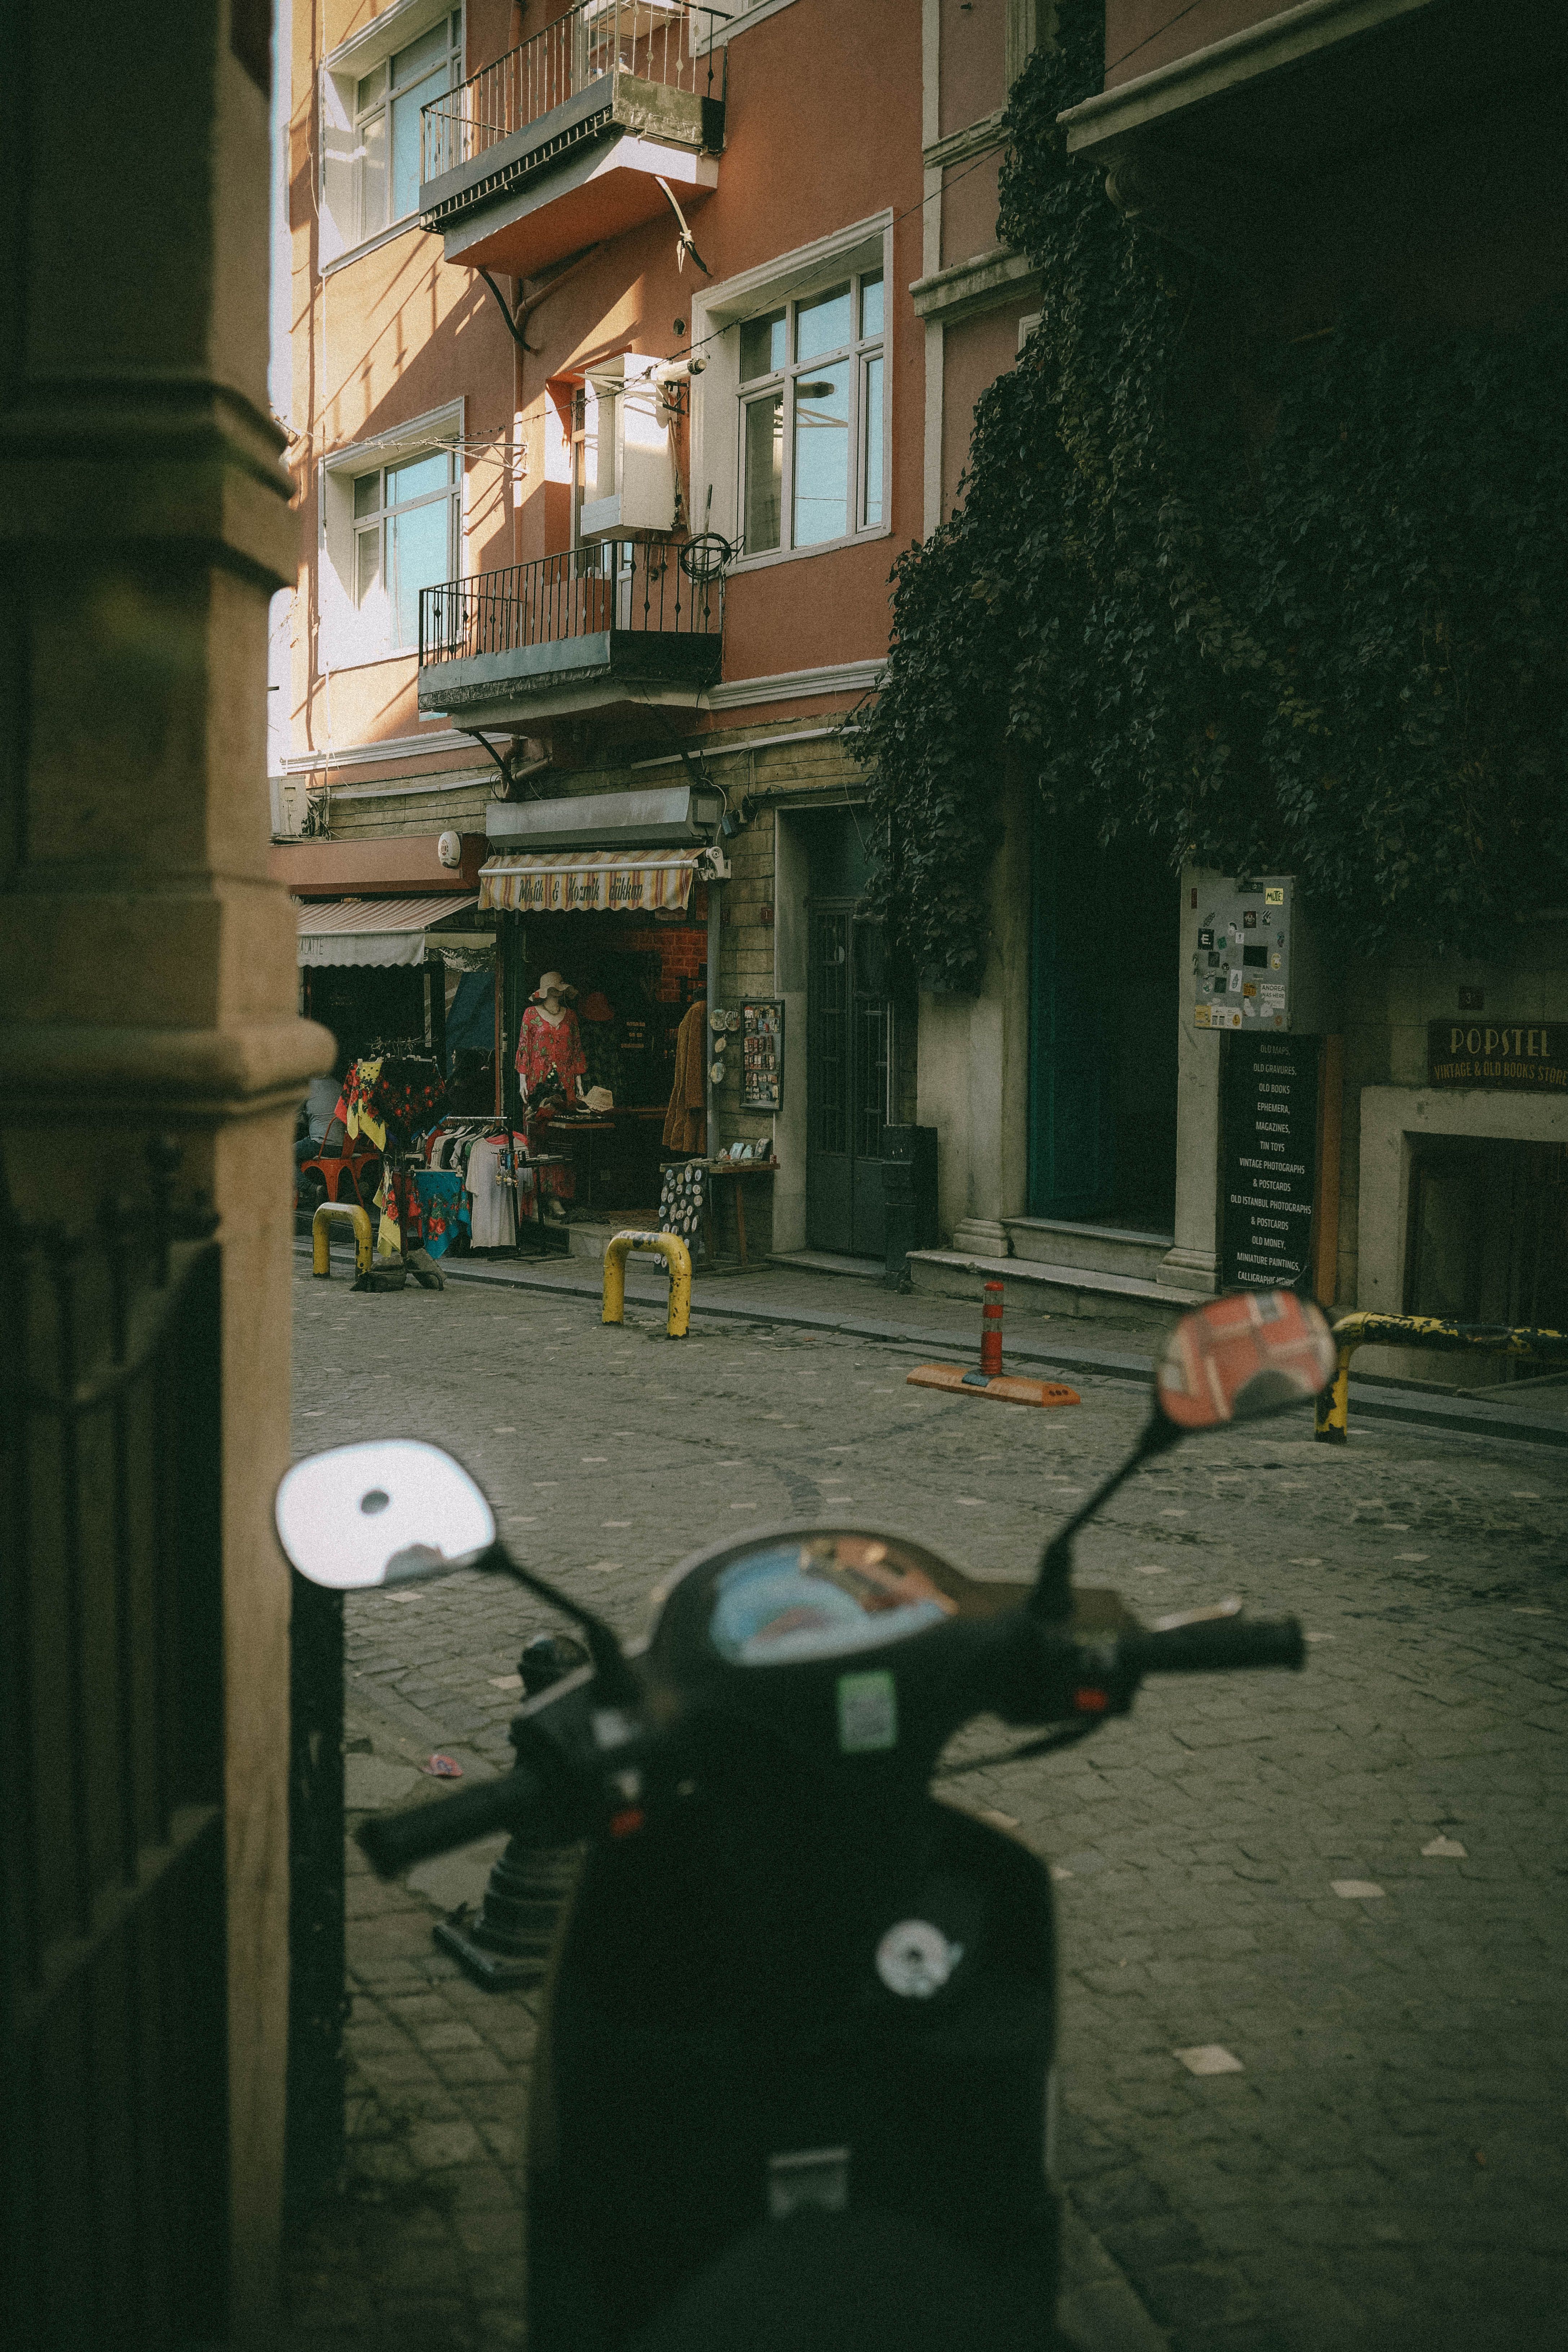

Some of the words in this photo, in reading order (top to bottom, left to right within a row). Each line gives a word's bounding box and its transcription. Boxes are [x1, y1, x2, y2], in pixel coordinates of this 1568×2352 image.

[552, 880, 559, 902] &
[568, 877, 600, 902] Kozmik
[609, 877, 643, 901] dükkan
[1261, 1045, 1271, 1053] OLD
[1450, 1028, 1550, 1057] POPSTEL
[1253, 1063, 1264, 1072] OLD
[1265, 1064, 1297, 1076] GRAVURES,
[1434, 1062, 1471, 1080] VINTAGE
[1474, 1062, 1481, 1076] &
[1484, 1061, 1501, 1076] OLD
[1504, 1062, 1535, 1079] BOOKS
[1538, 1066, 1568, 1086] STORE
[1259, 1083, 1270, 1091] OLD
[1271, 1084, 1290, 1094] BOOKS
[1257, 1102, 1290, 1115] EPHEMERA,
[1256, 1121, 1290, 1134] MAGAZINES,
[1261, 1141, 1269, 1150] TIN
[1271, 1142, 1285, 1152] TOYS
[1240, 1157, 1262, 1168] VINTAGE
[1263, 1161, 1305, 1174] PHOTOGRAPHS
[1253, 1179, 1257, 1187] &
[1259, 1179, 1291, 1192] POSTCARDS
[1231, 1195, 1241, 1203] OLD
[1243, 1196, 1269, 1208] ISTANBUL
[1270, 1200, 1311, 1214] PHOTOGRAPHS
[1251, 1217, 1256, 1225] &
[1257, 1217, 1289, 1230] POSTCARDS
[1252, 1236, 1262, 1245] OLD
[1264, 1237, 1286, 1250] MONEY,
[1237, 1252, 1267, 1265] MINIATURE
[1269, 1257, 1300, 1272] PAINTINGS,
[1238, 1271, 1274, 1285] CALLIGRAPHIC
